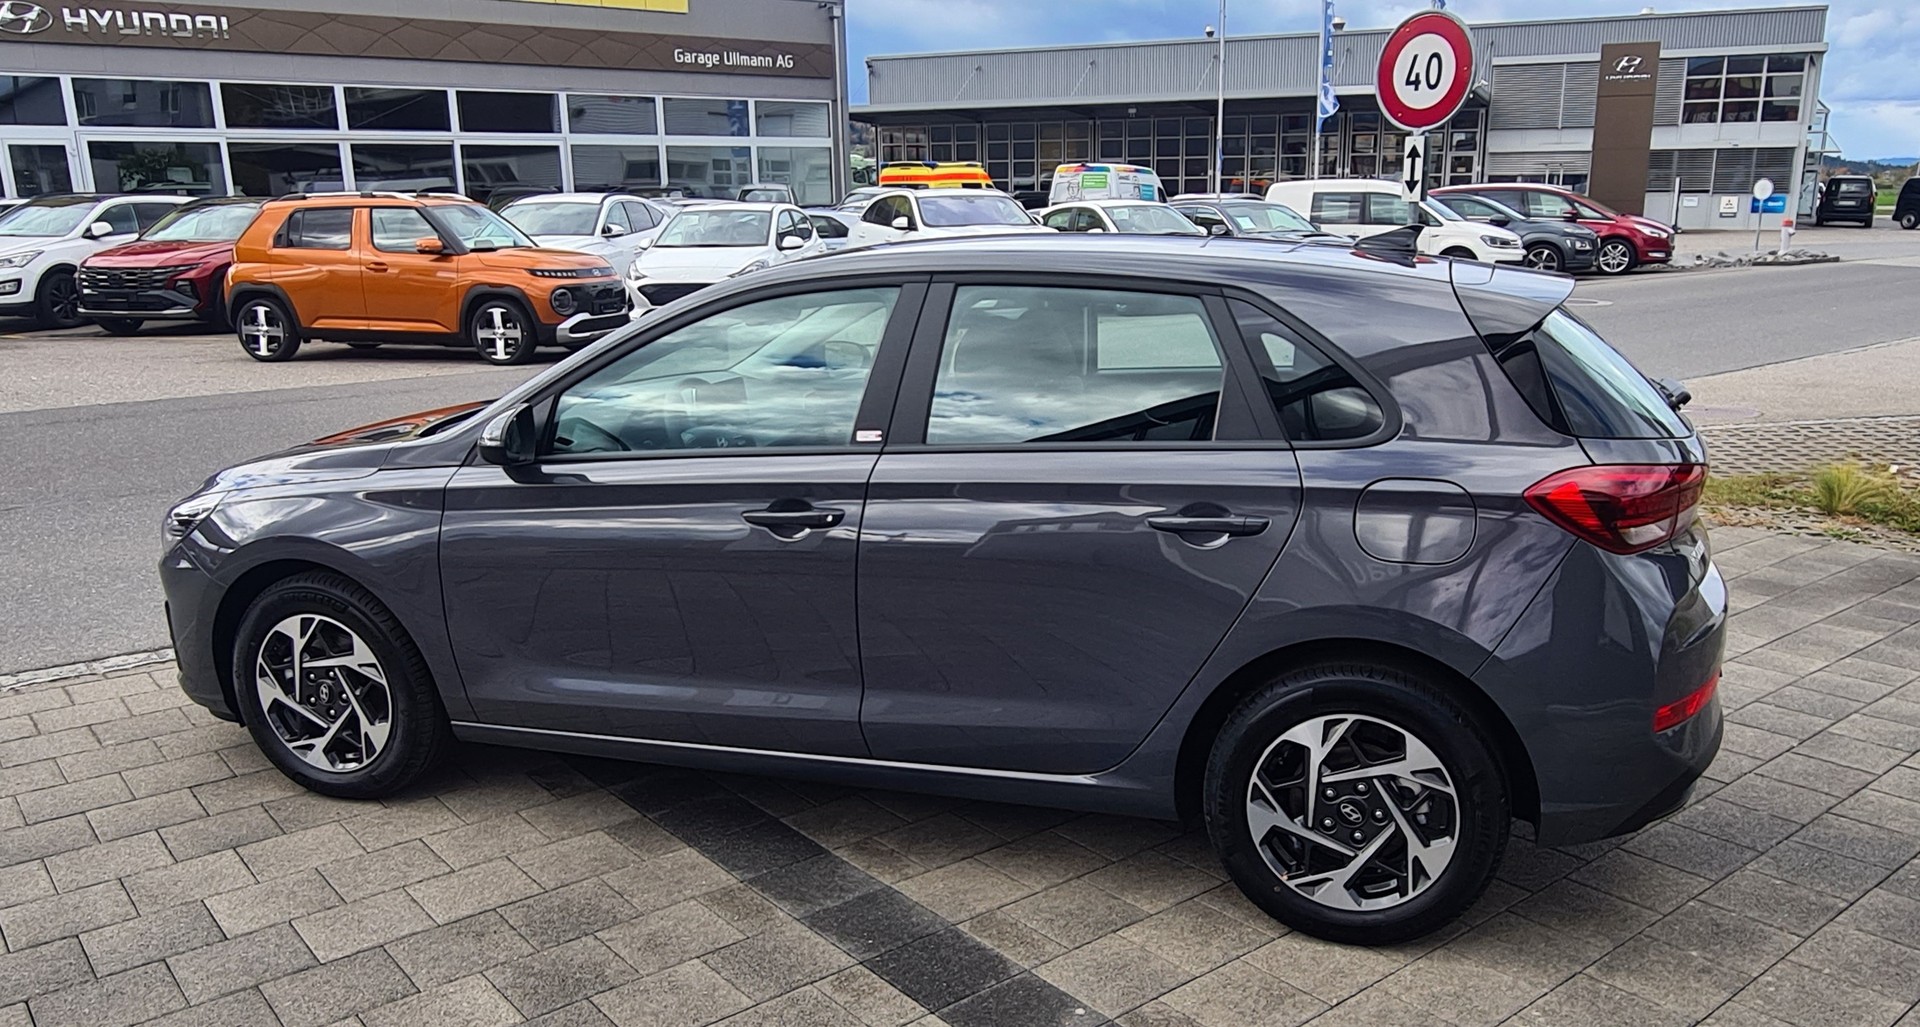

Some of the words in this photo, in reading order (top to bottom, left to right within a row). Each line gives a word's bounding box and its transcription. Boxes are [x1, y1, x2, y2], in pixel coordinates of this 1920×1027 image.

[61, 7, 230, 40] HYUNDAI
[674, 49, 720, 68] Garage
[724, 51, 773, 68] Ullmann
[776, 54, 794, 69] AG
[1405, 51, 1443, 92] 40
